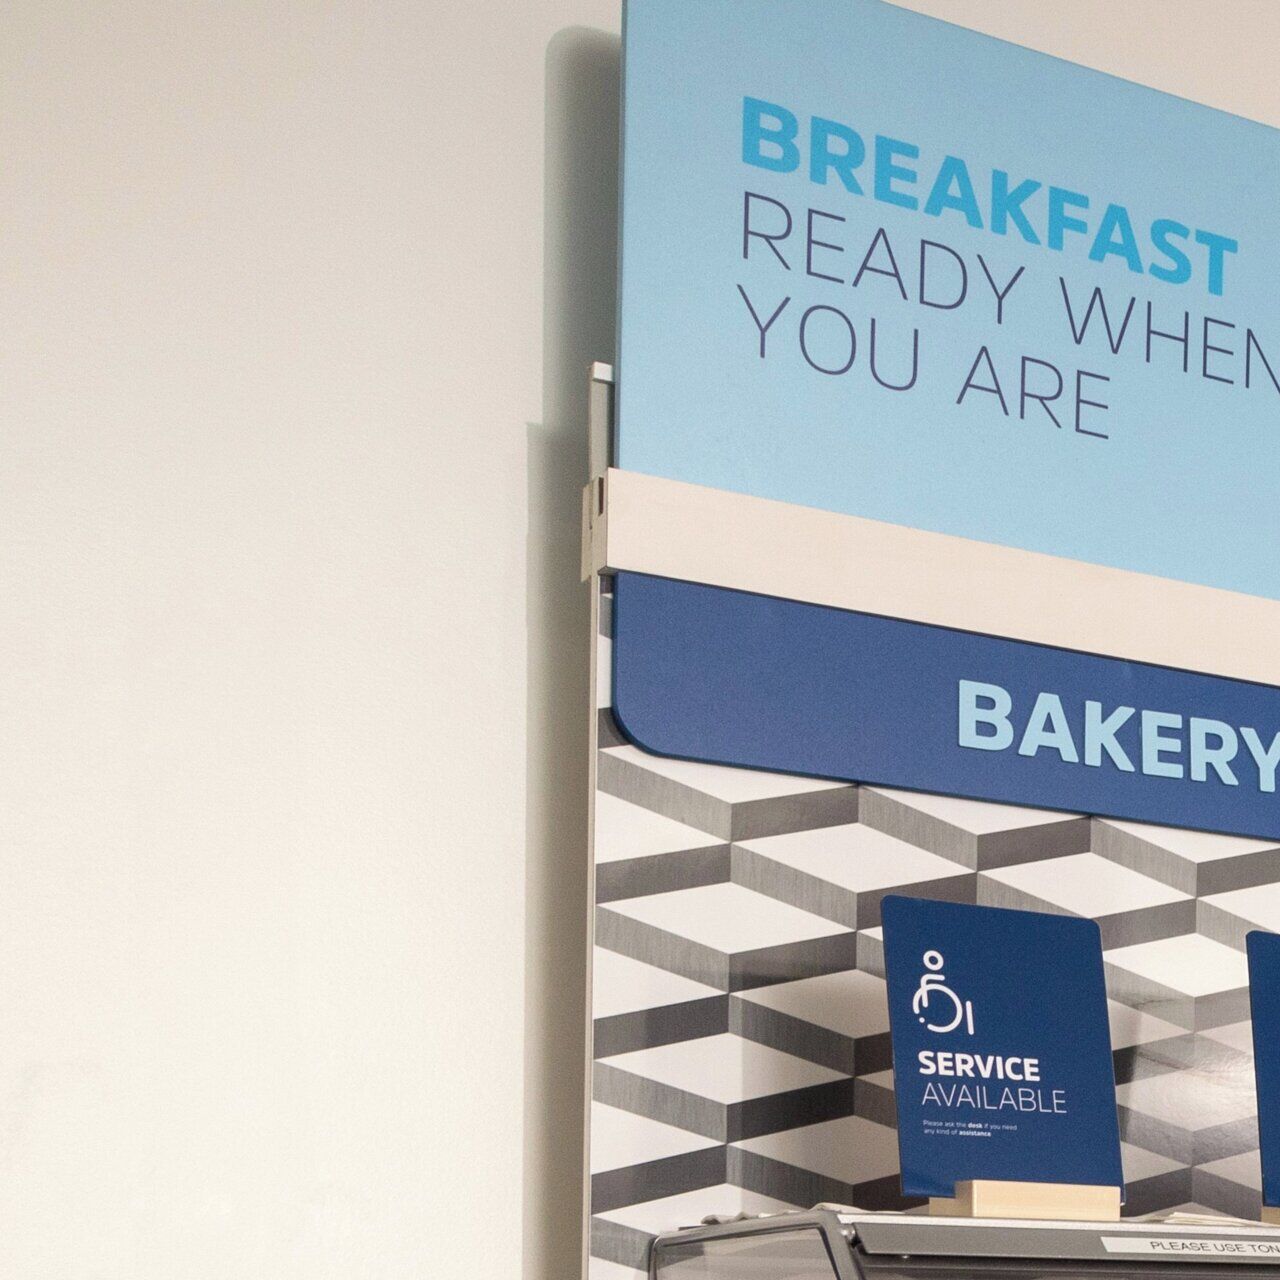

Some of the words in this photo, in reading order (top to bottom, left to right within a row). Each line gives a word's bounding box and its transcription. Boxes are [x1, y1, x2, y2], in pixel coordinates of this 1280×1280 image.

[742, 96, 1238, 296] BREAKFAST
[743, 191, 1025, 324] READY
[737, 283, 919, 392] YOU
[956, 345, 1109, 440] ARE
[918, 1050, 1040, 1081] SERVICE
[922, 1082, 1067, 1113] AVAILABLE
[1150, 1241, 1211, 1253] PLEASE
[1213, 1244, 1247, 1254] USE
